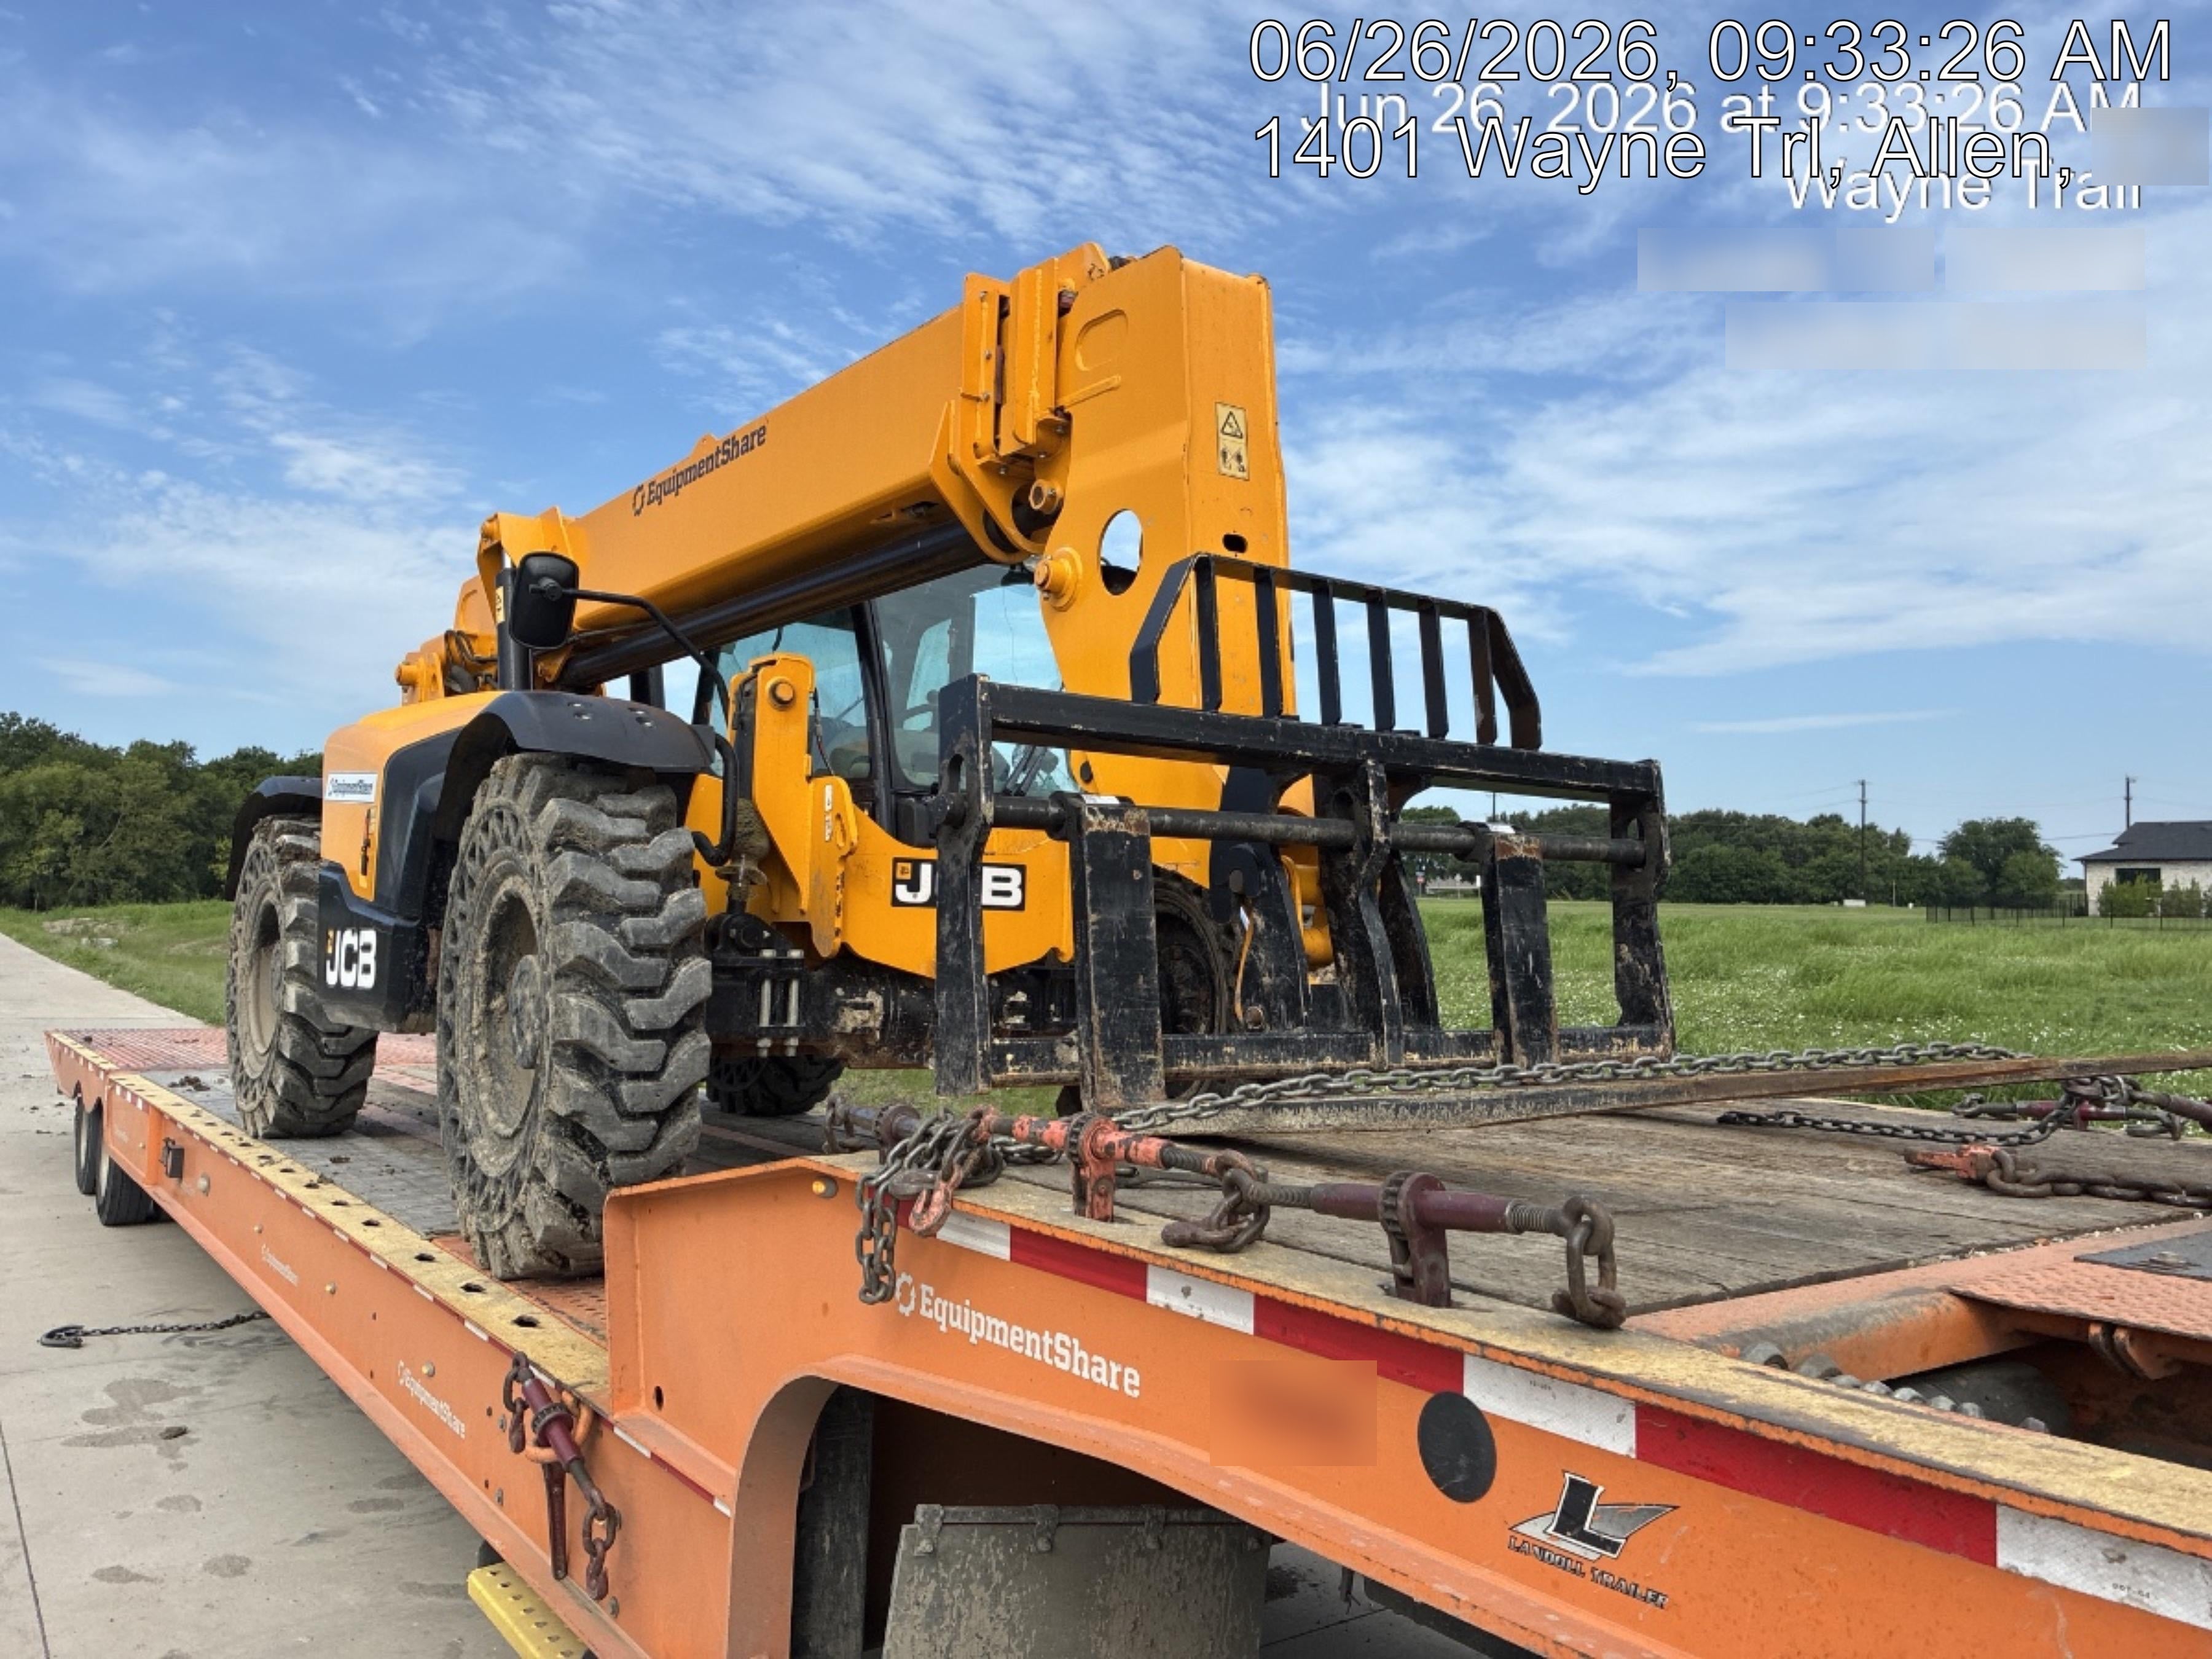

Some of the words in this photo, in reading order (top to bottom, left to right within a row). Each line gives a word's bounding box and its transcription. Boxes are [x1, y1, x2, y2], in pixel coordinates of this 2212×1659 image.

[646, 425, 767, 506] EquipmentShare
[895, 862, 1023, 907] JB
[326, 928, 377, 989] JCB
[919, 1283, 1141, 1398] EquipmentShare
